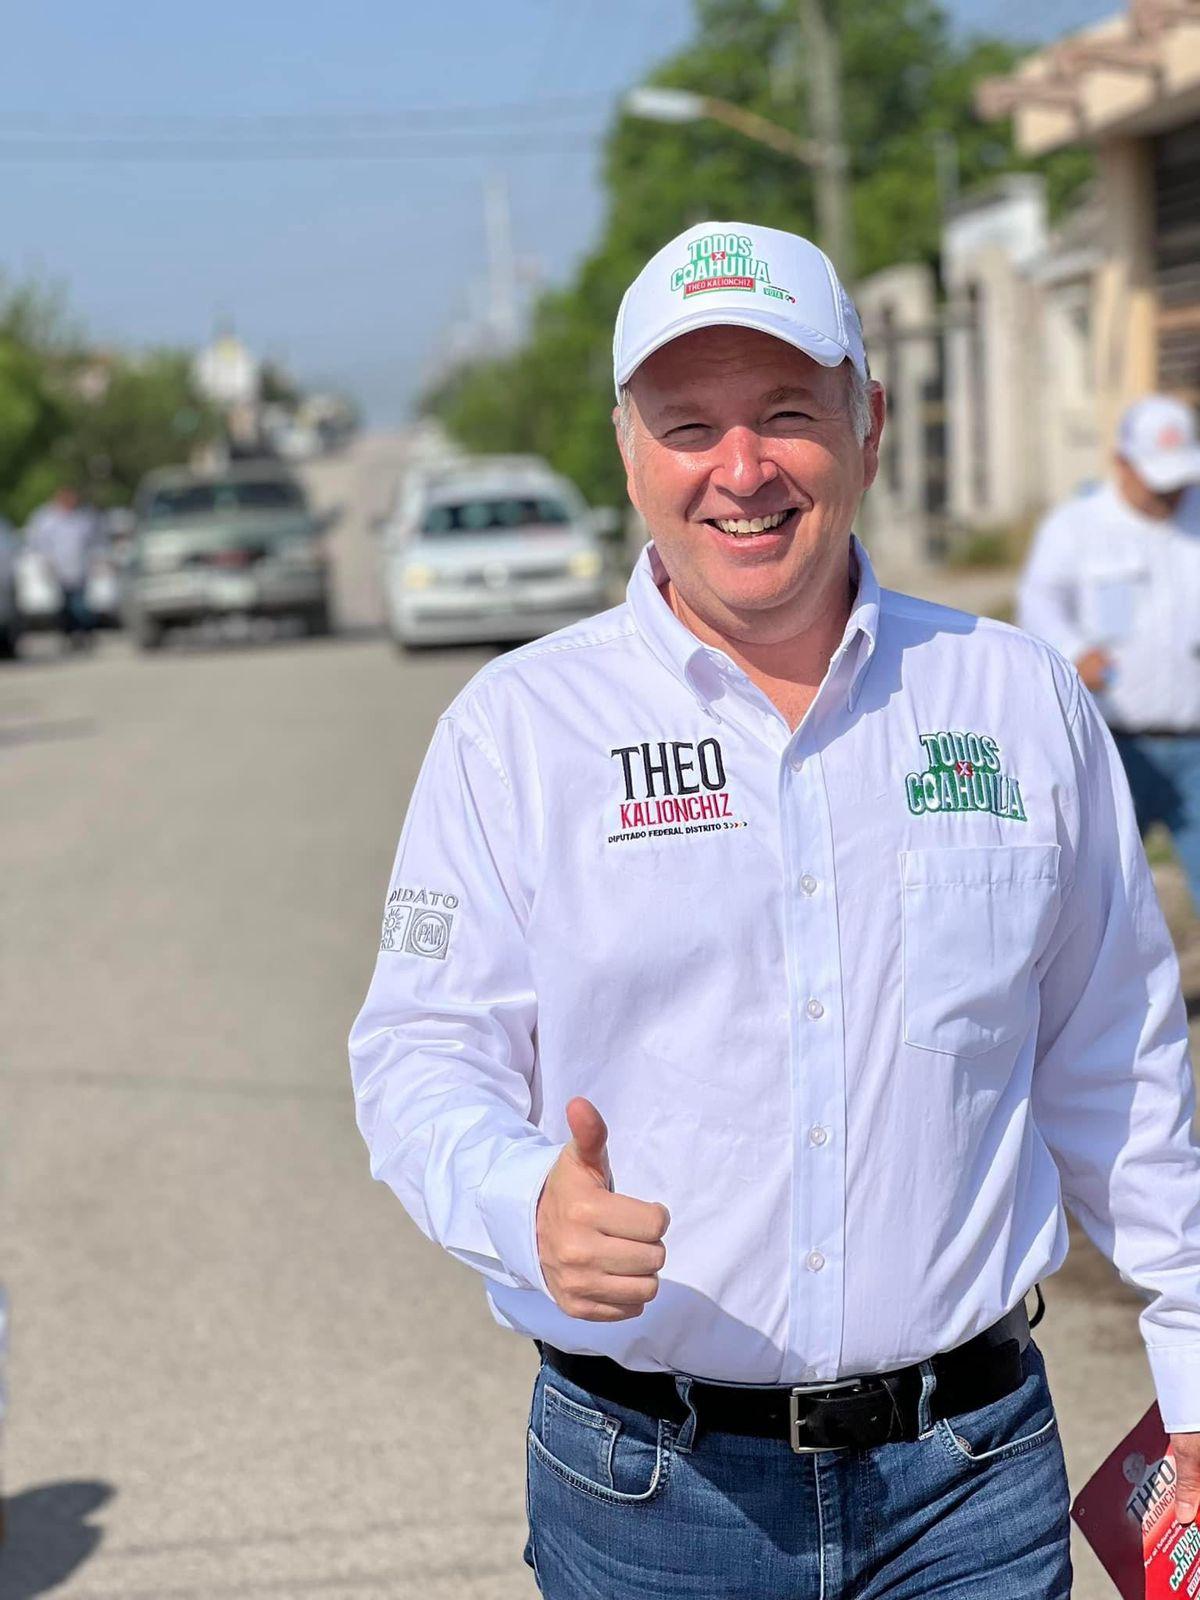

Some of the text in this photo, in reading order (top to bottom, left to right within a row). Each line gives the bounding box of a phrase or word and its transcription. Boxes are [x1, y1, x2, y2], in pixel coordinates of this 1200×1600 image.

[687, 234, 752, 262] TODOS
[671, 256, 771, 291] COAHUILA
[687, 277, 753, 292] THEO KALIONCHIZ
[763, 287, 784, 300] VOTA
[610, 737, 727, 800] THEO
[919, 731, 1000, 773] TODOS
[619, 793, 733, 829] KALIONCHIZ
[905, 771, 1028, 822] COAHUILA
[608, 830, 646, 843] DIPUTADO
[648, 826, 683, 838] FEDERAL
[685, 823, 722, 834] DISTRITO
[418, 923, 443, 946] PAN
[1126, 1459, 1176, 1523] THEO
[1169, 1522, 1200, 1565] TODOS
